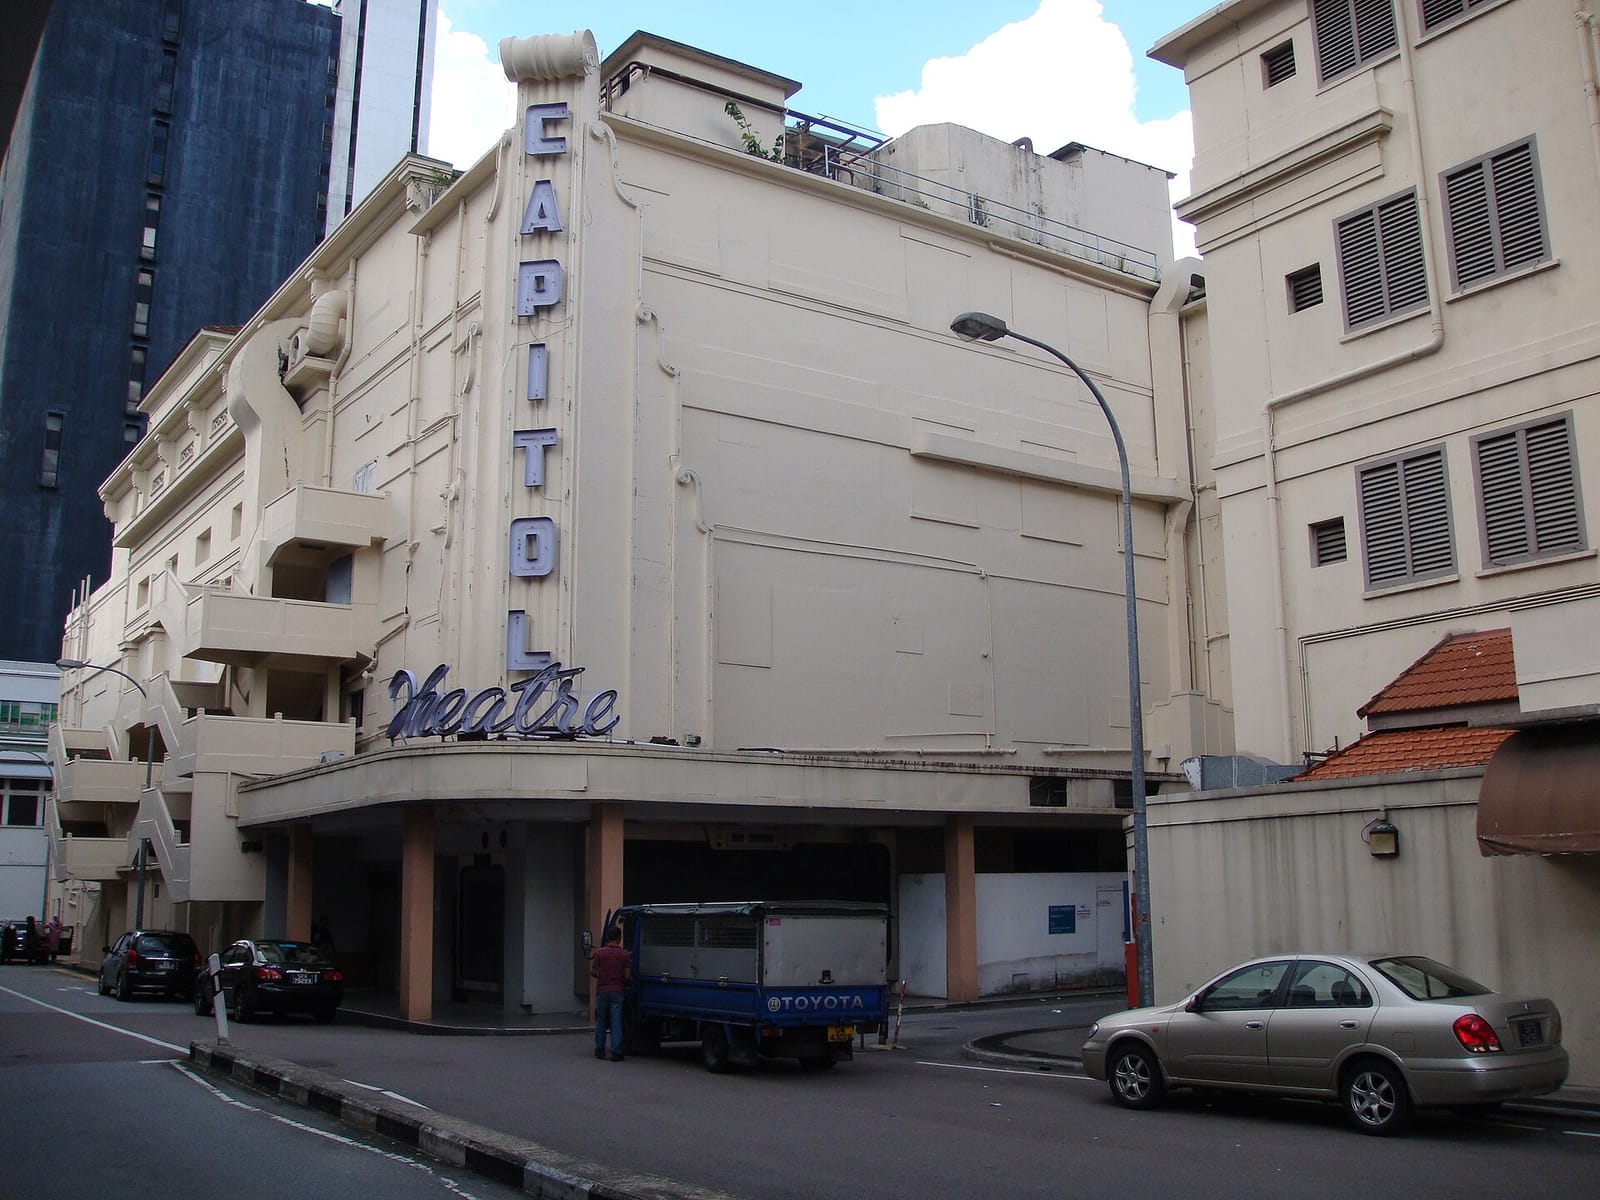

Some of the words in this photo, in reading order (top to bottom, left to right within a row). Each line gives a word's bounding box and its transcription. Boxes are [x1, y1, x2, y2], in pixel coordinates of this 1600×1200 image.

[505, 101, 569, 672] CAPITOL
[386, 662, 620, 739] Theatre
[781, 995, 864, 1010] TOYOTA
